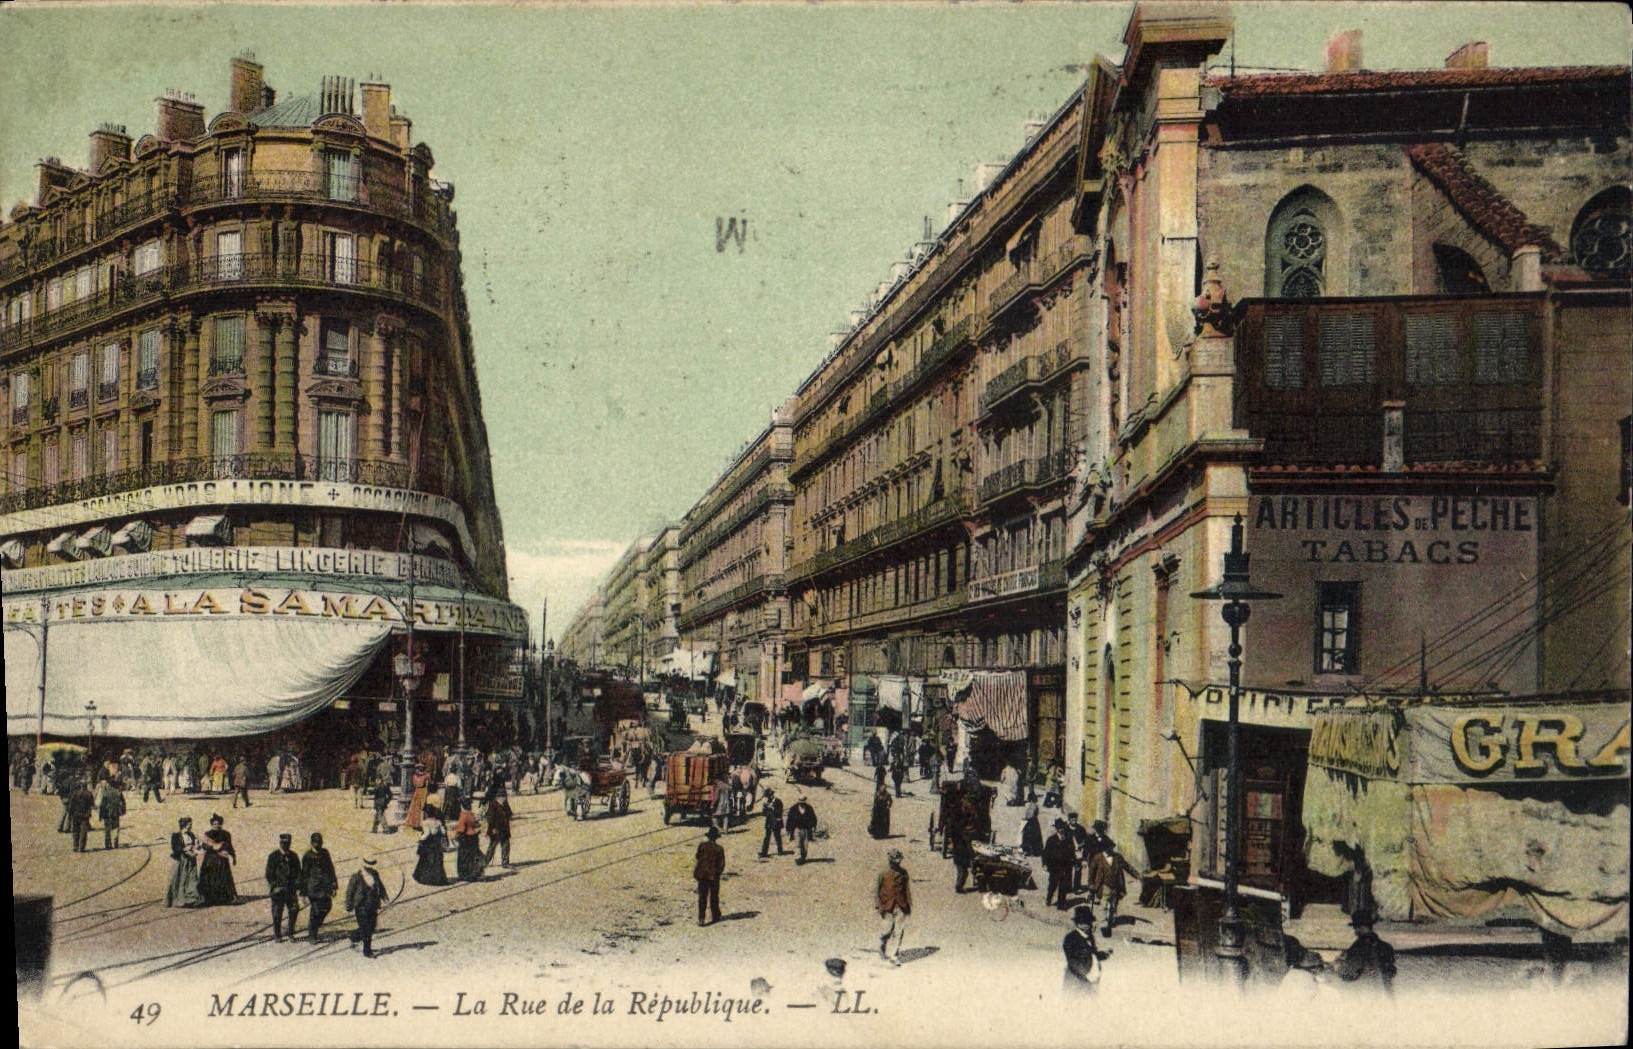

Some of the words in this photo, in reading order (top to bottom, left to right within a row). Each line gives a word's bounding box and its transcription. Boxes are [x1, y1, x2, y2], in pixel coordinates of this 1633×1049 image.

[1255, 496, 1411, 531] ARTICLES
[1415, 517, 1429, 531] DE
[173, 549, 259, 574] TOILERIE
[276, 549, 384, 575] LINGERIE
[1302, 540, 1480, 565] TABACS
